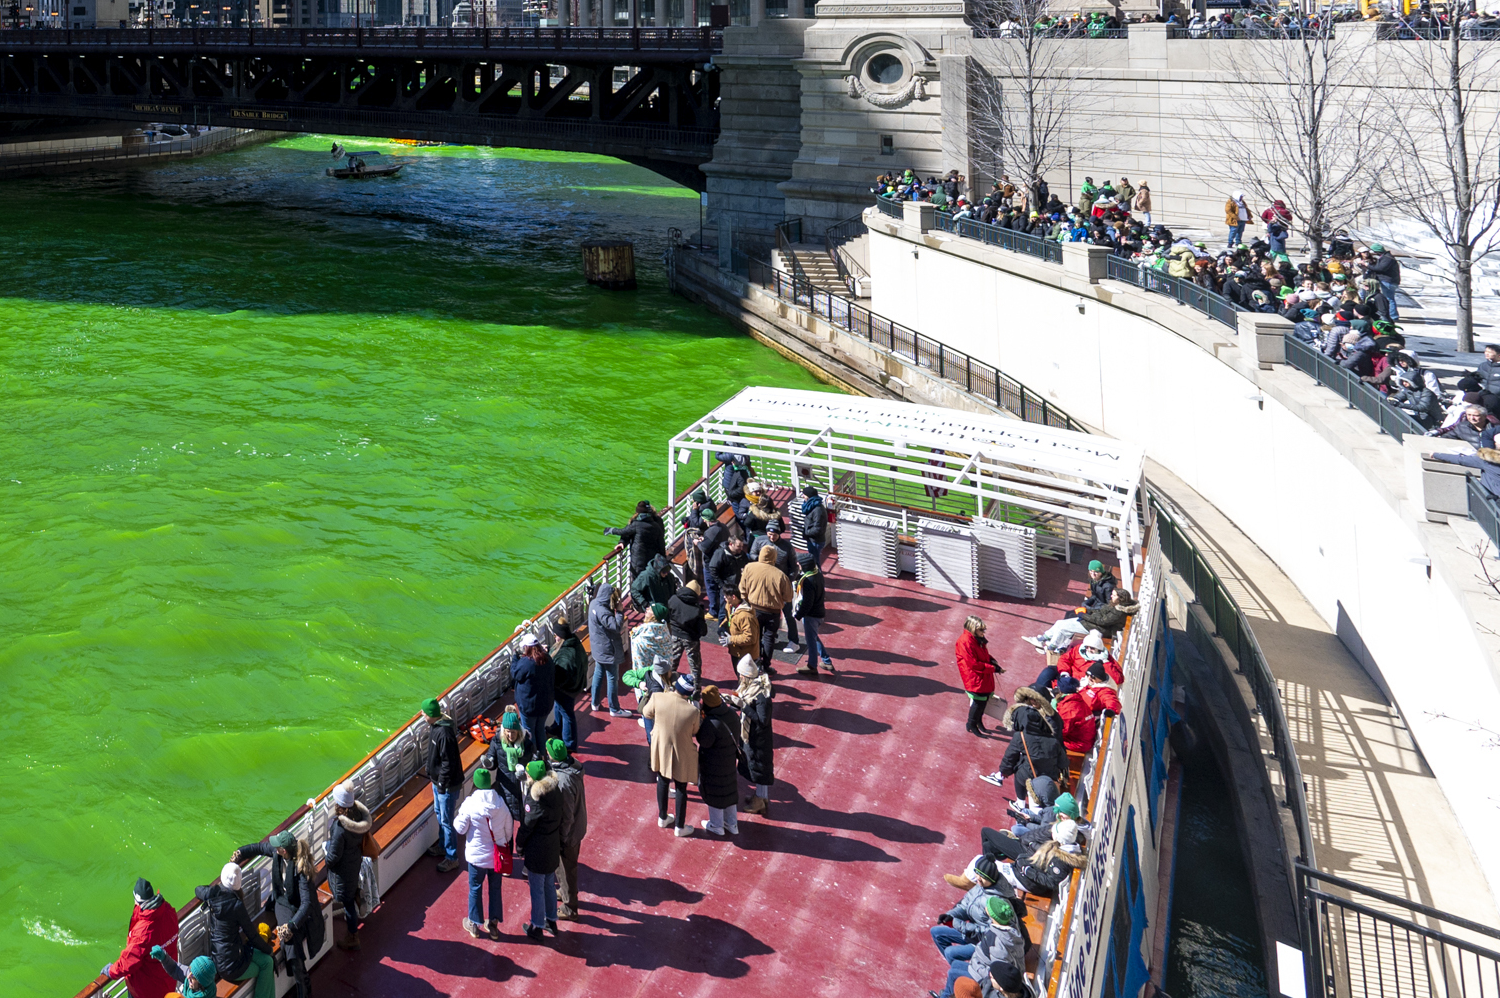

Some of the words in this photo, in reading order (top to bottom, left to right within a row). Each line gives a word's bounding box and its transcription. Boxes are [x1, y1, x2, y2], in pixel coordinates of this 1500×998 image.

[749, 398, 840, 411] America
[941, 421, 1040, 444] Popular
[1053, 442, 1120, 461] Most
[1083, 775, 1117, 955] Sightseeing
